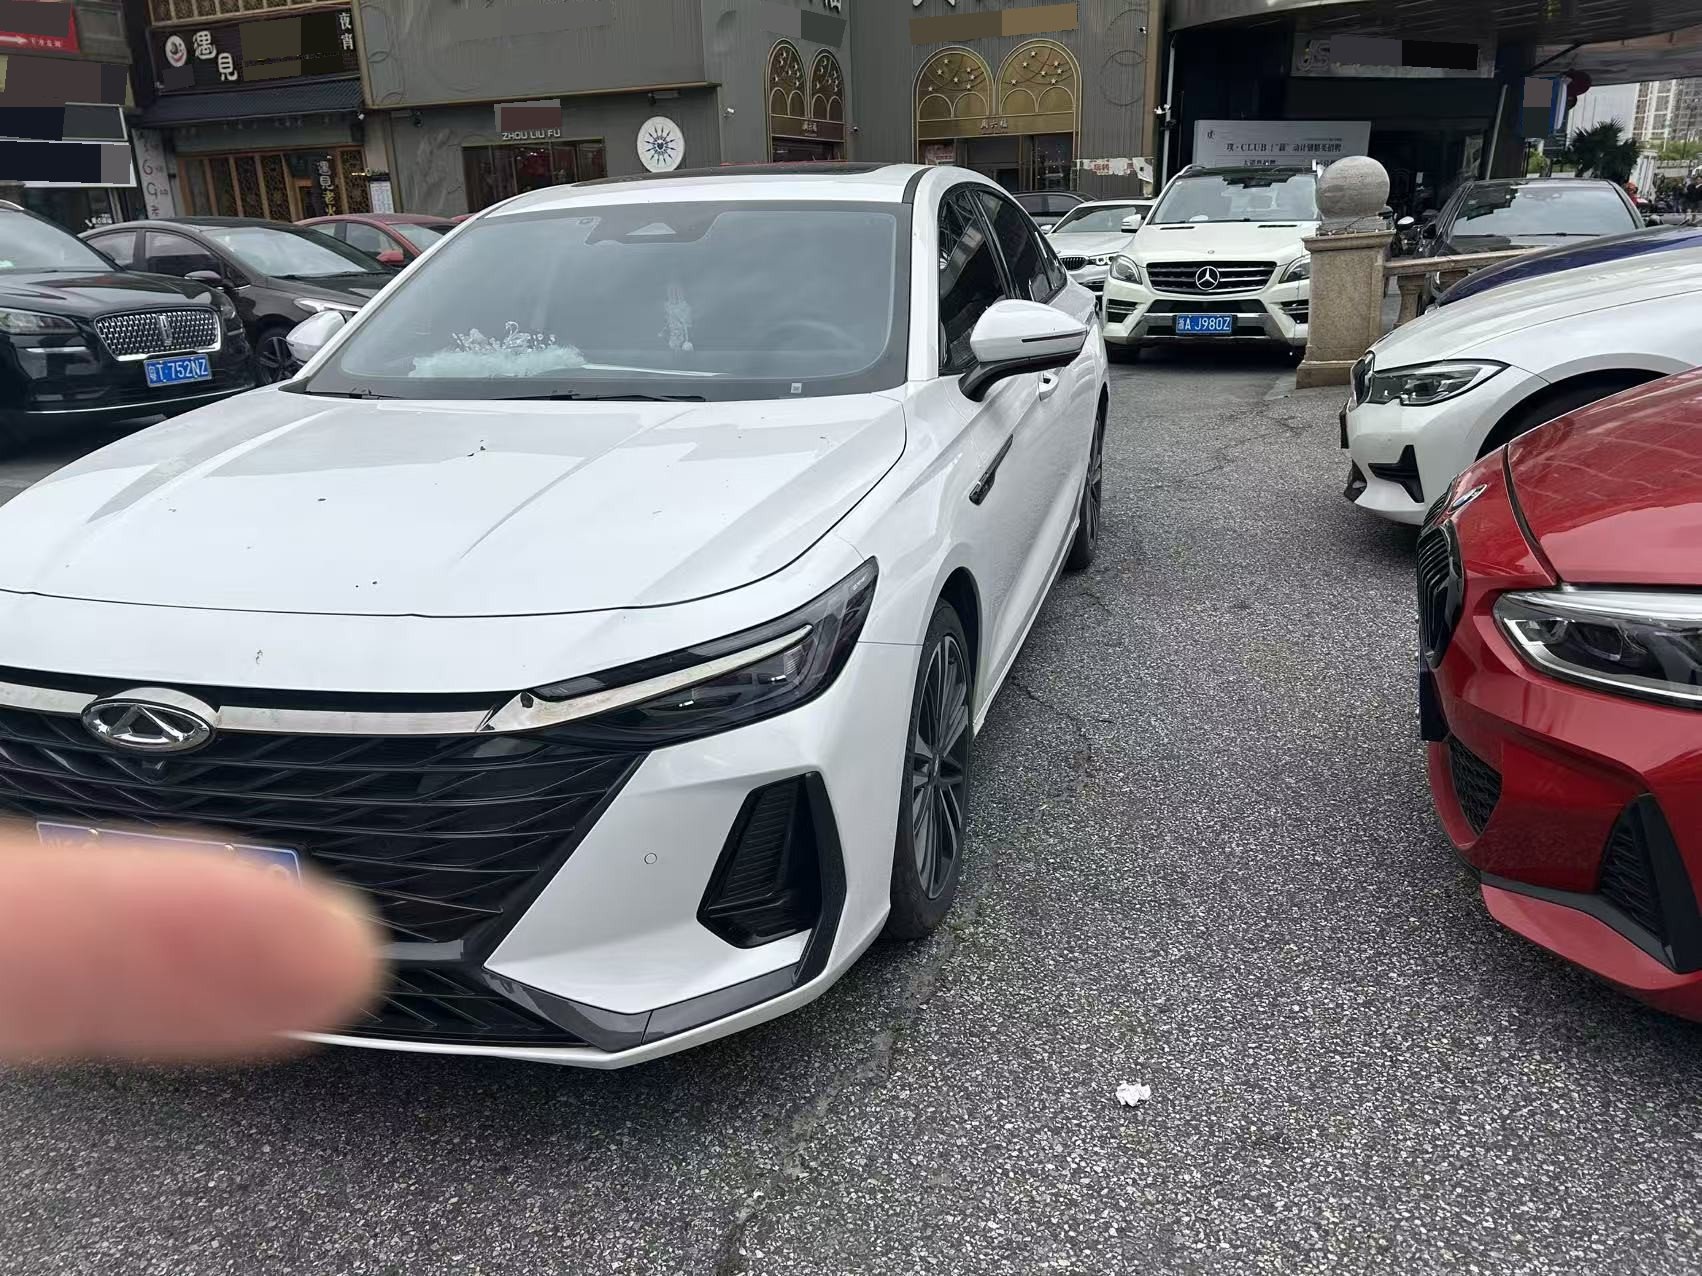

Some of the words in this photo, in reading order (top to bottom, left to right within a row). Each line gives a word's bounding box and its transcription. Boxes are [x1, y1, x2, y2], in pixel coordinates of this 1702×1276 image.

[339, 12, 354, 50] 夜宵
[502, 132, 527, 140] ZHOU
[530, 129, 545, 139] LIU
[547, 128, 560, 138] FU
